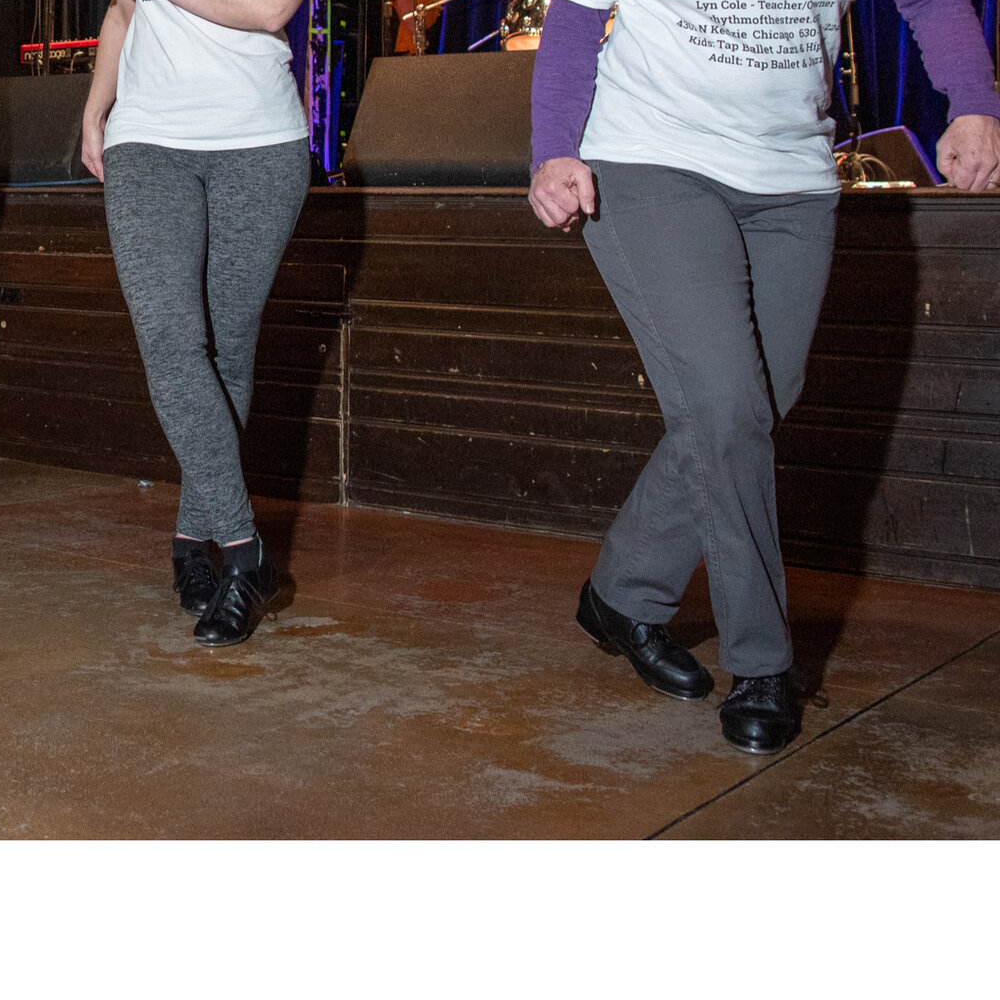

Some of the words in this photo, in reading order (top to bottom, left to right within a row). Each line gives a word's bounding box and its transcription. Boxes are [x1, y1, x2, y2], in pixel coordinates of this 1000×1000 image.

[696, 0, 718, 13] Lyn
[720, 0, 747, 10] Cole
[757, 0, 836, 11] Teacher/Owner
[698, 24, 707, 34] N
[752, 29, 795, 42] Chicago
[716, 40, 739, 52] Tap
[742, 43, 774, 56] Ballet
[709, 53, 743, 66] Adult:
[746, 57, 769, 71] Tap
[771, 58, 800, 70] Ballet
[801, 58, 808, 68] &
